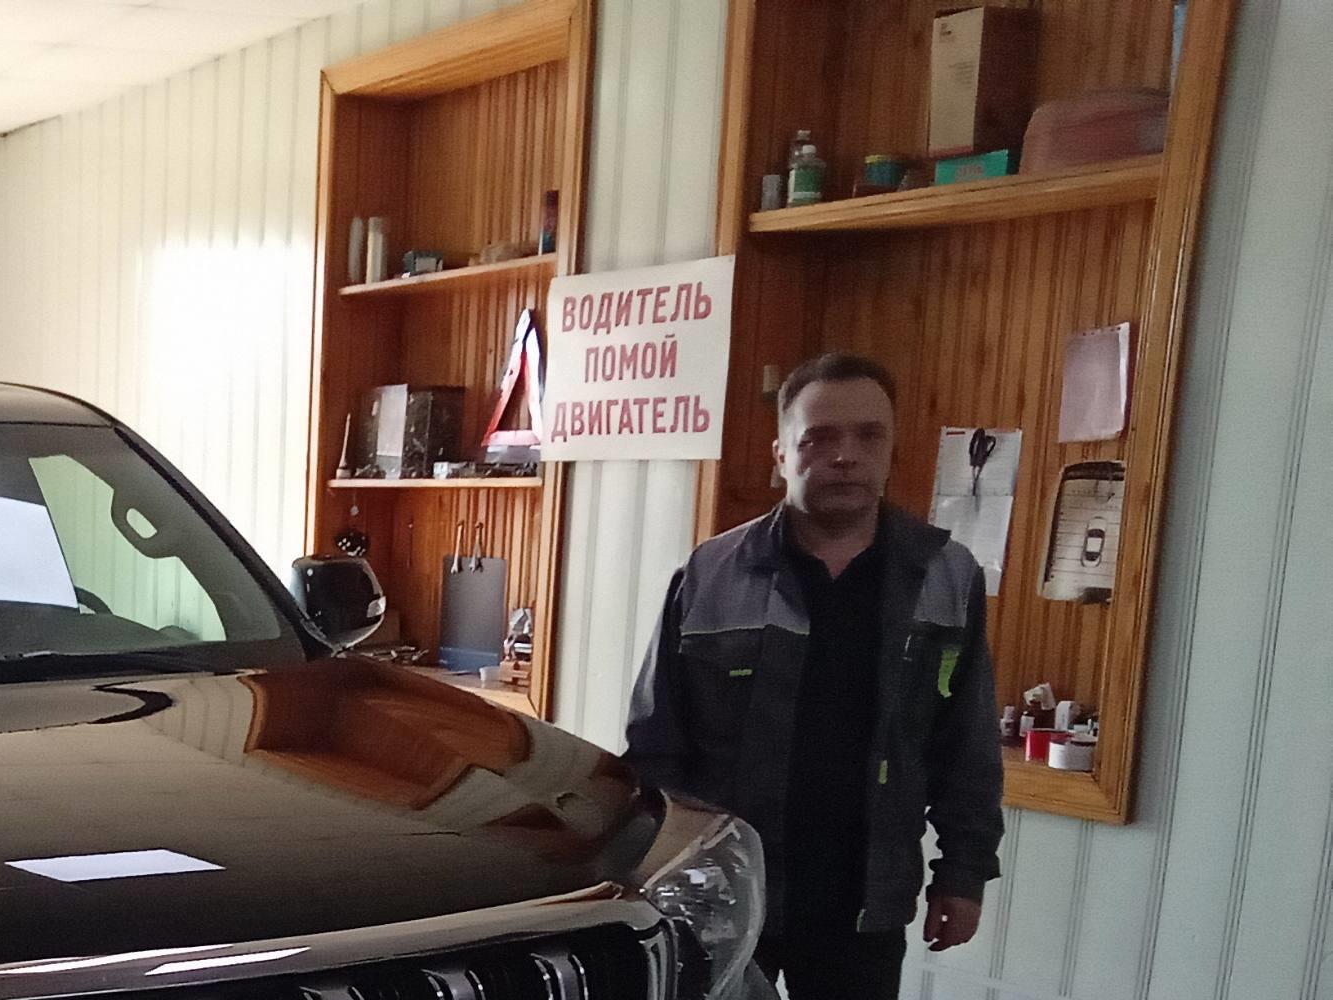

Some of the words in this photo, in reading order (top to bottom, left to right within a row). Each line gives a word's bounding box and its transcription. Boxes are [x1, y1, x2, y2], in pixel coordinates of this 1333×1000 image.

[562, 281, 712, 335] ВОДИТЕЛЬ
[584, 333, 677, 383] ПОМОЙ
[551, 395, 710, 442] ДВИГАТЕЛЬ
